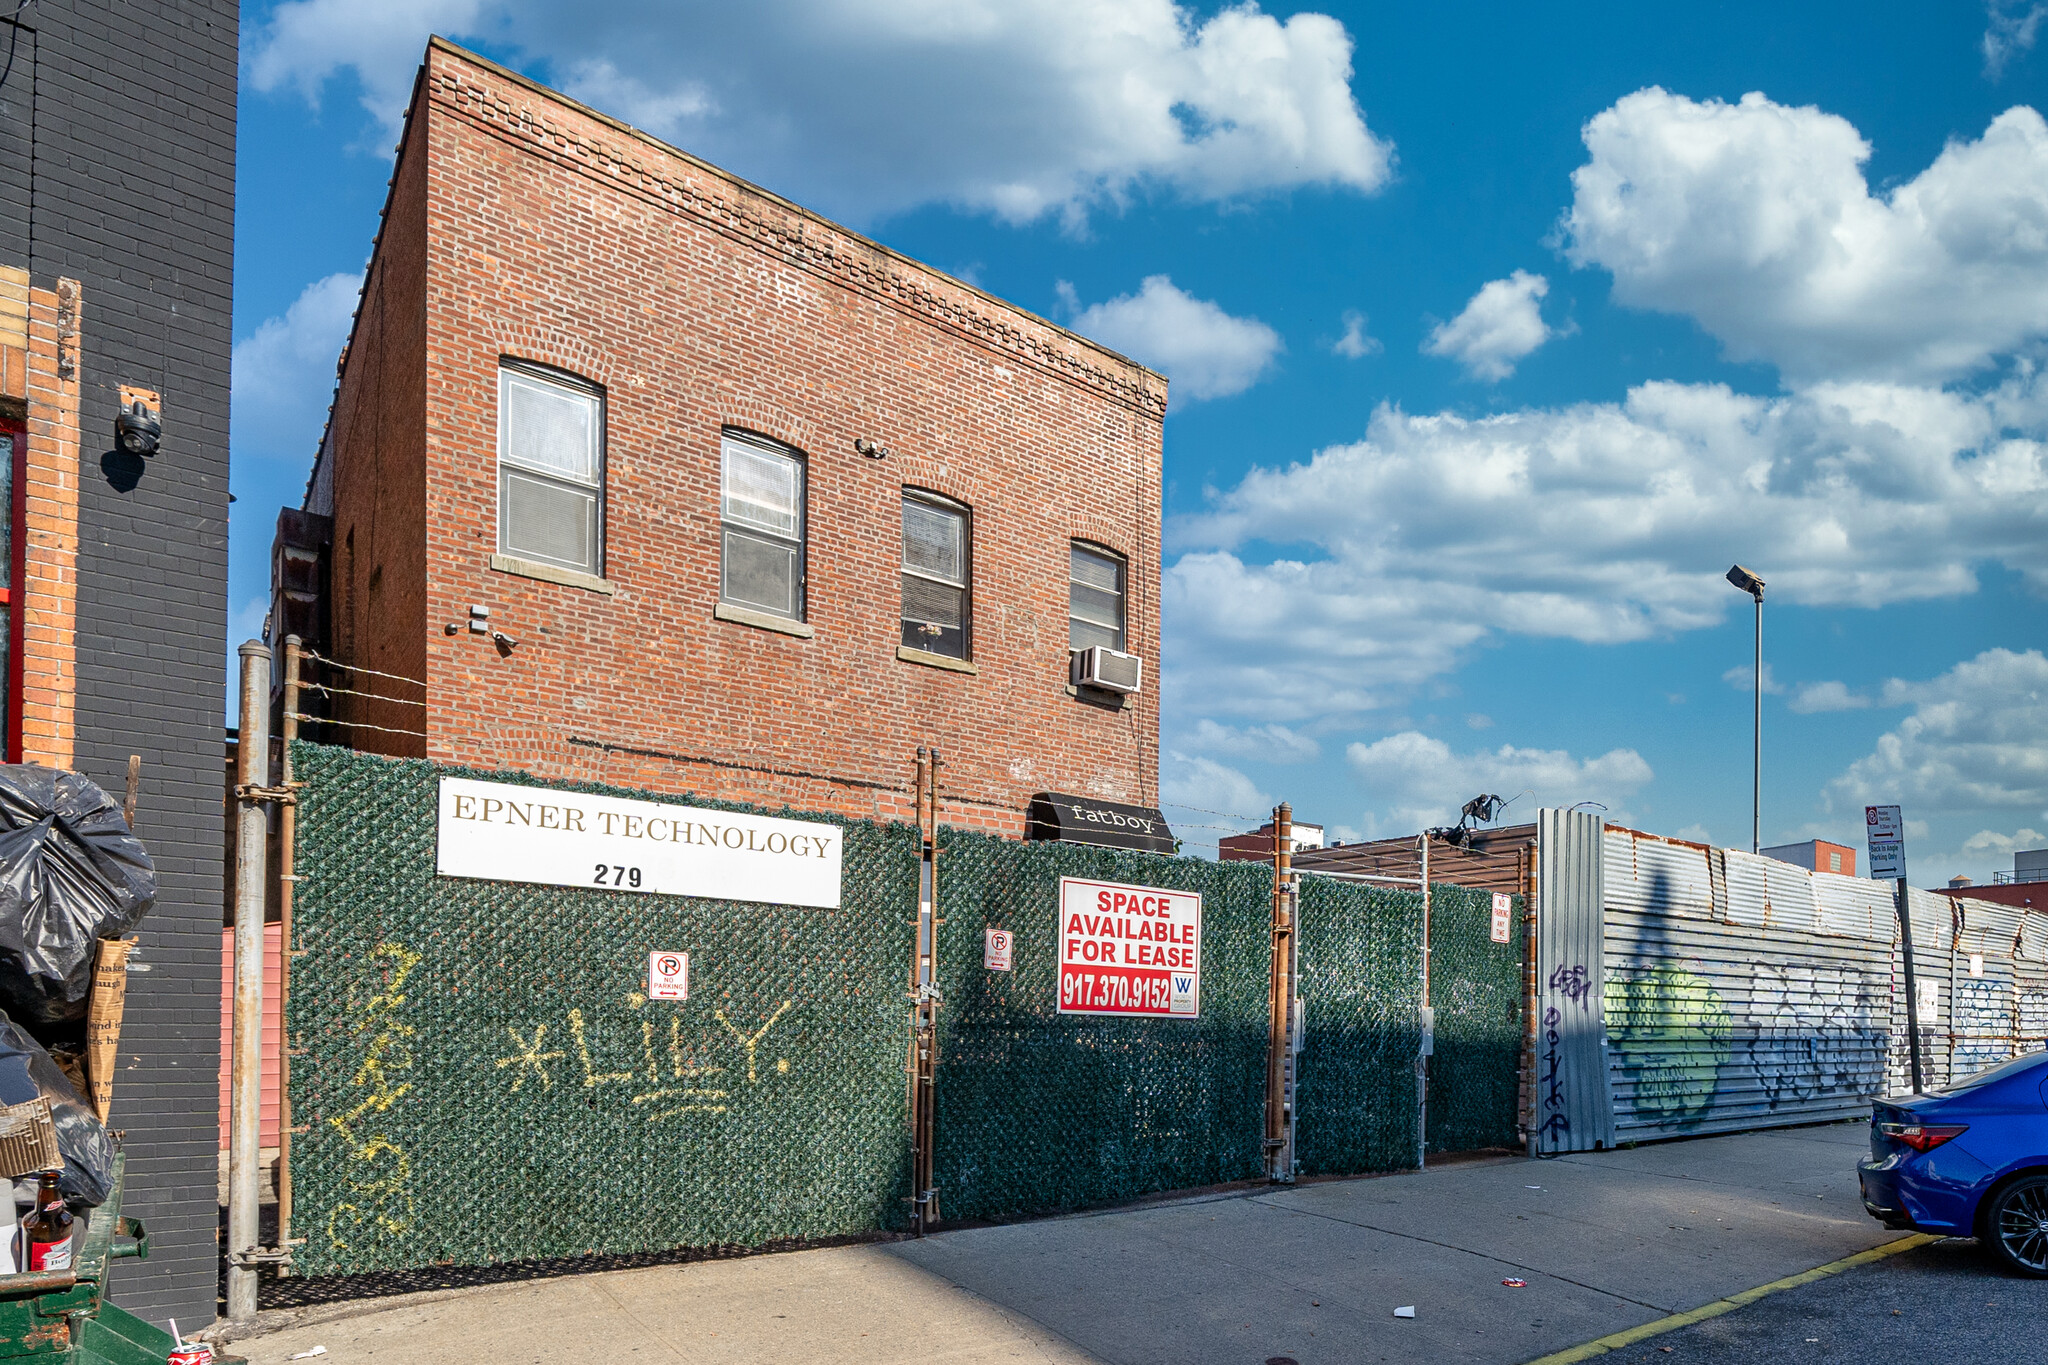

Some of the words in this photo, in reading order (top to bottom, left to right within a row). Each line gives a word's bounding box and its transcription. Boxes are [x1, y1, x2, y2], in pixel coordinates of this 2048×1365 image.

[452, 794, 587, 832] EPNER
[597, 811, 832, 859] TECHNOLOGY
[1871, 853, 1888, 861] Parking
[593, 863, 642, 888] 279
[1097, 890, 1171, 919] SPACE
[1498, 899, 1505, 907] NO
[1494, 908, 1508, 918] PARKING
[1066, 913, 1194, 945] AVAILABLE
[1496, 929, 1505, 937] TIME
[988, 955, 1009, 963] PARKING
[1067, 938, 1117, 963] FOR
[1124, 943, 1194, 969] LEASE
[653, 982, 684, 990] PARKING
[663, 976, 674, 984] NO
[1175, 977, 1192, 993] W
[1063, 972, 1170, 1009] 917.370.9152
